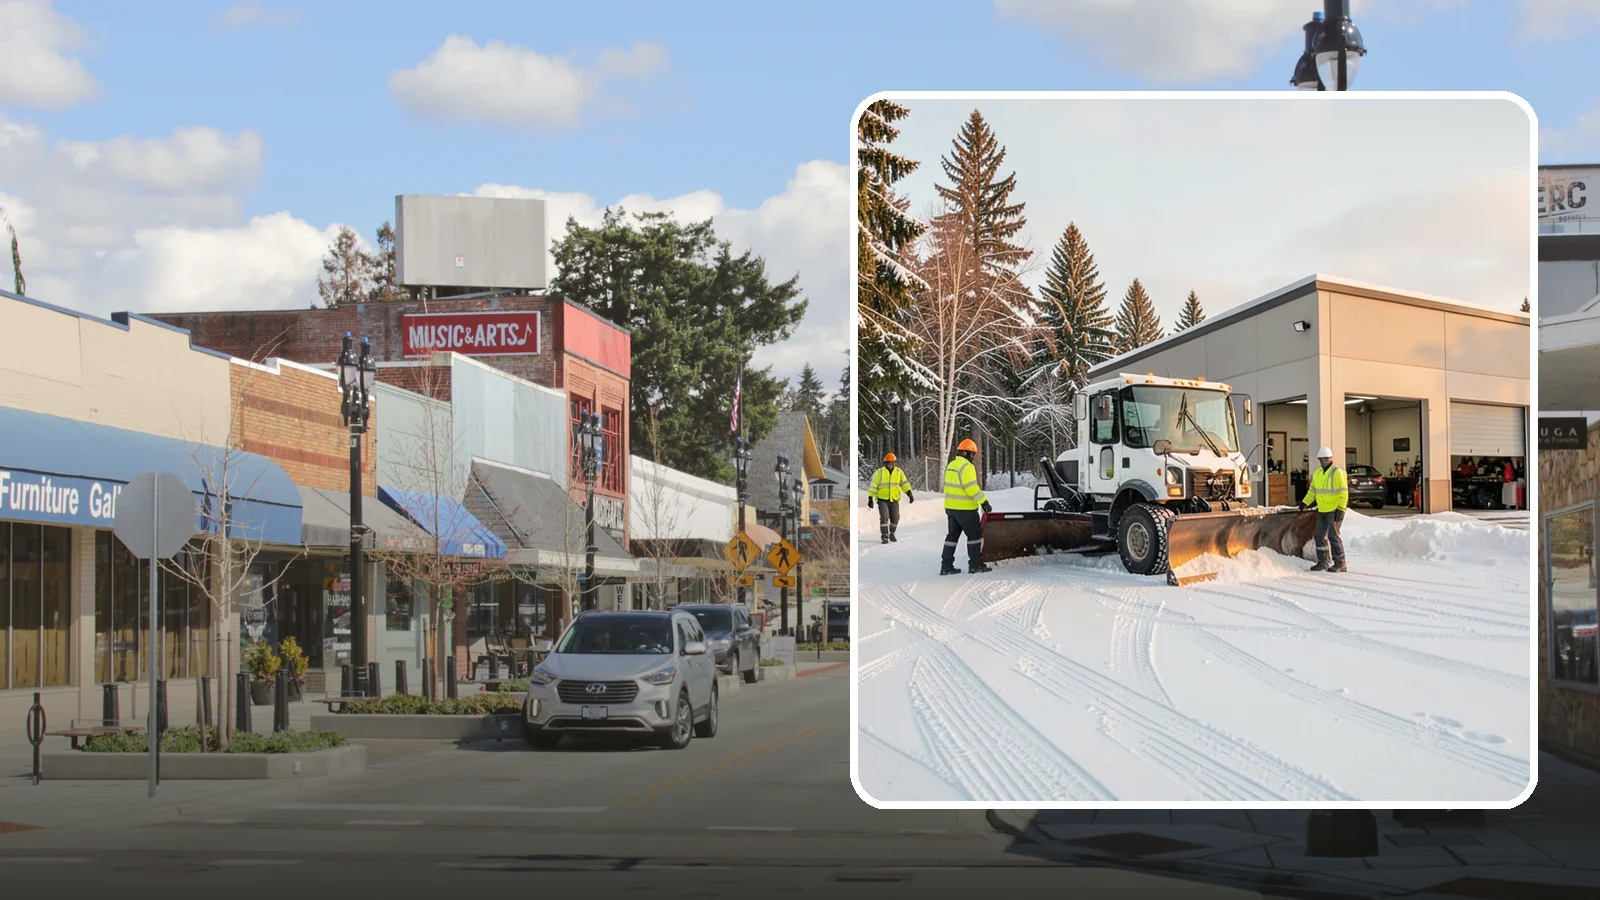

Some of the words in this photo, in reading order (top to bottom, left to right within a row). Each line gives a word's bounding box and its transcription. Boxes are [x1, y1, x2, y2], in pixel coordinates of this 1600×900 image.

[1540, 427, 1577, 436] UGA
[0, 471, 79, 516] Furniture
[89, 482, 122, 519] Gal
